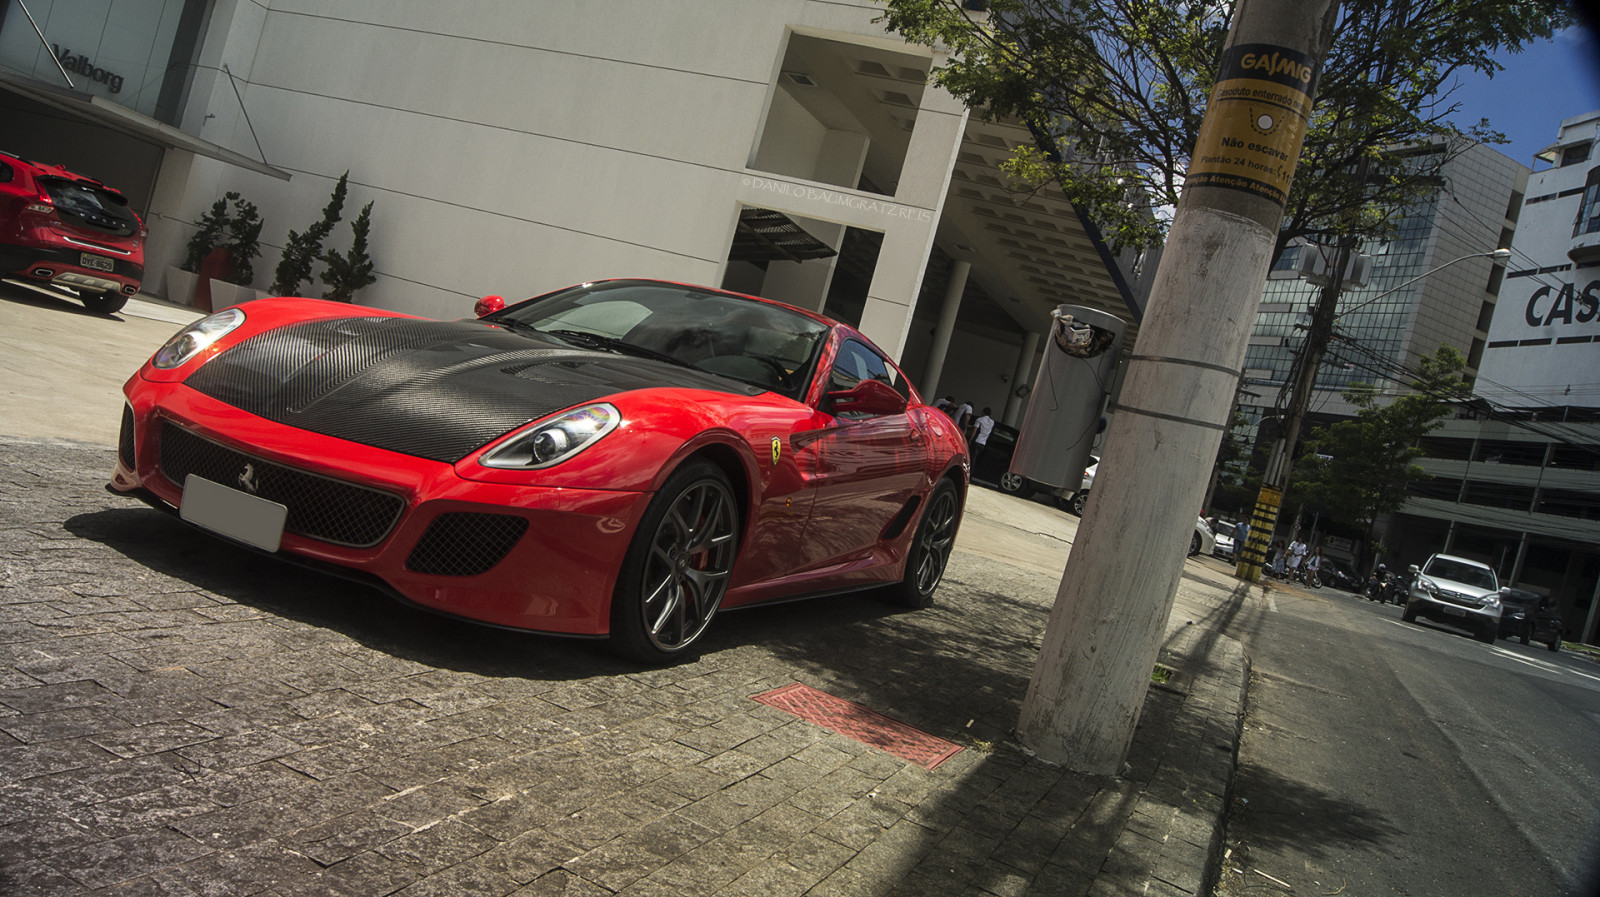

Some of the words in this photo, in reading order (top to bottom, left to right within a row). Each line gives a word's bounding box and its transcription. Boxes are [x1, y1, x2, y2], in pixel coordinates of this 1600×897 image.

[52, 43, 124, 94] Valborg
[1241, 51, 1312, 84] GASMIG
[1252, 88, 1292, 105] enterrado
[1201, 155, 1231, 164] Plantão
[1233, 157, 1245, 166] 24
[1221, 137, 1245, 149] Não
[1248, 143, 1289, 162] escavar
[1210, 175, 1247, 188] Atenção
[1250, 181, 1280, 199] Atenção
[1525, 280, 1600, 328] CAS
